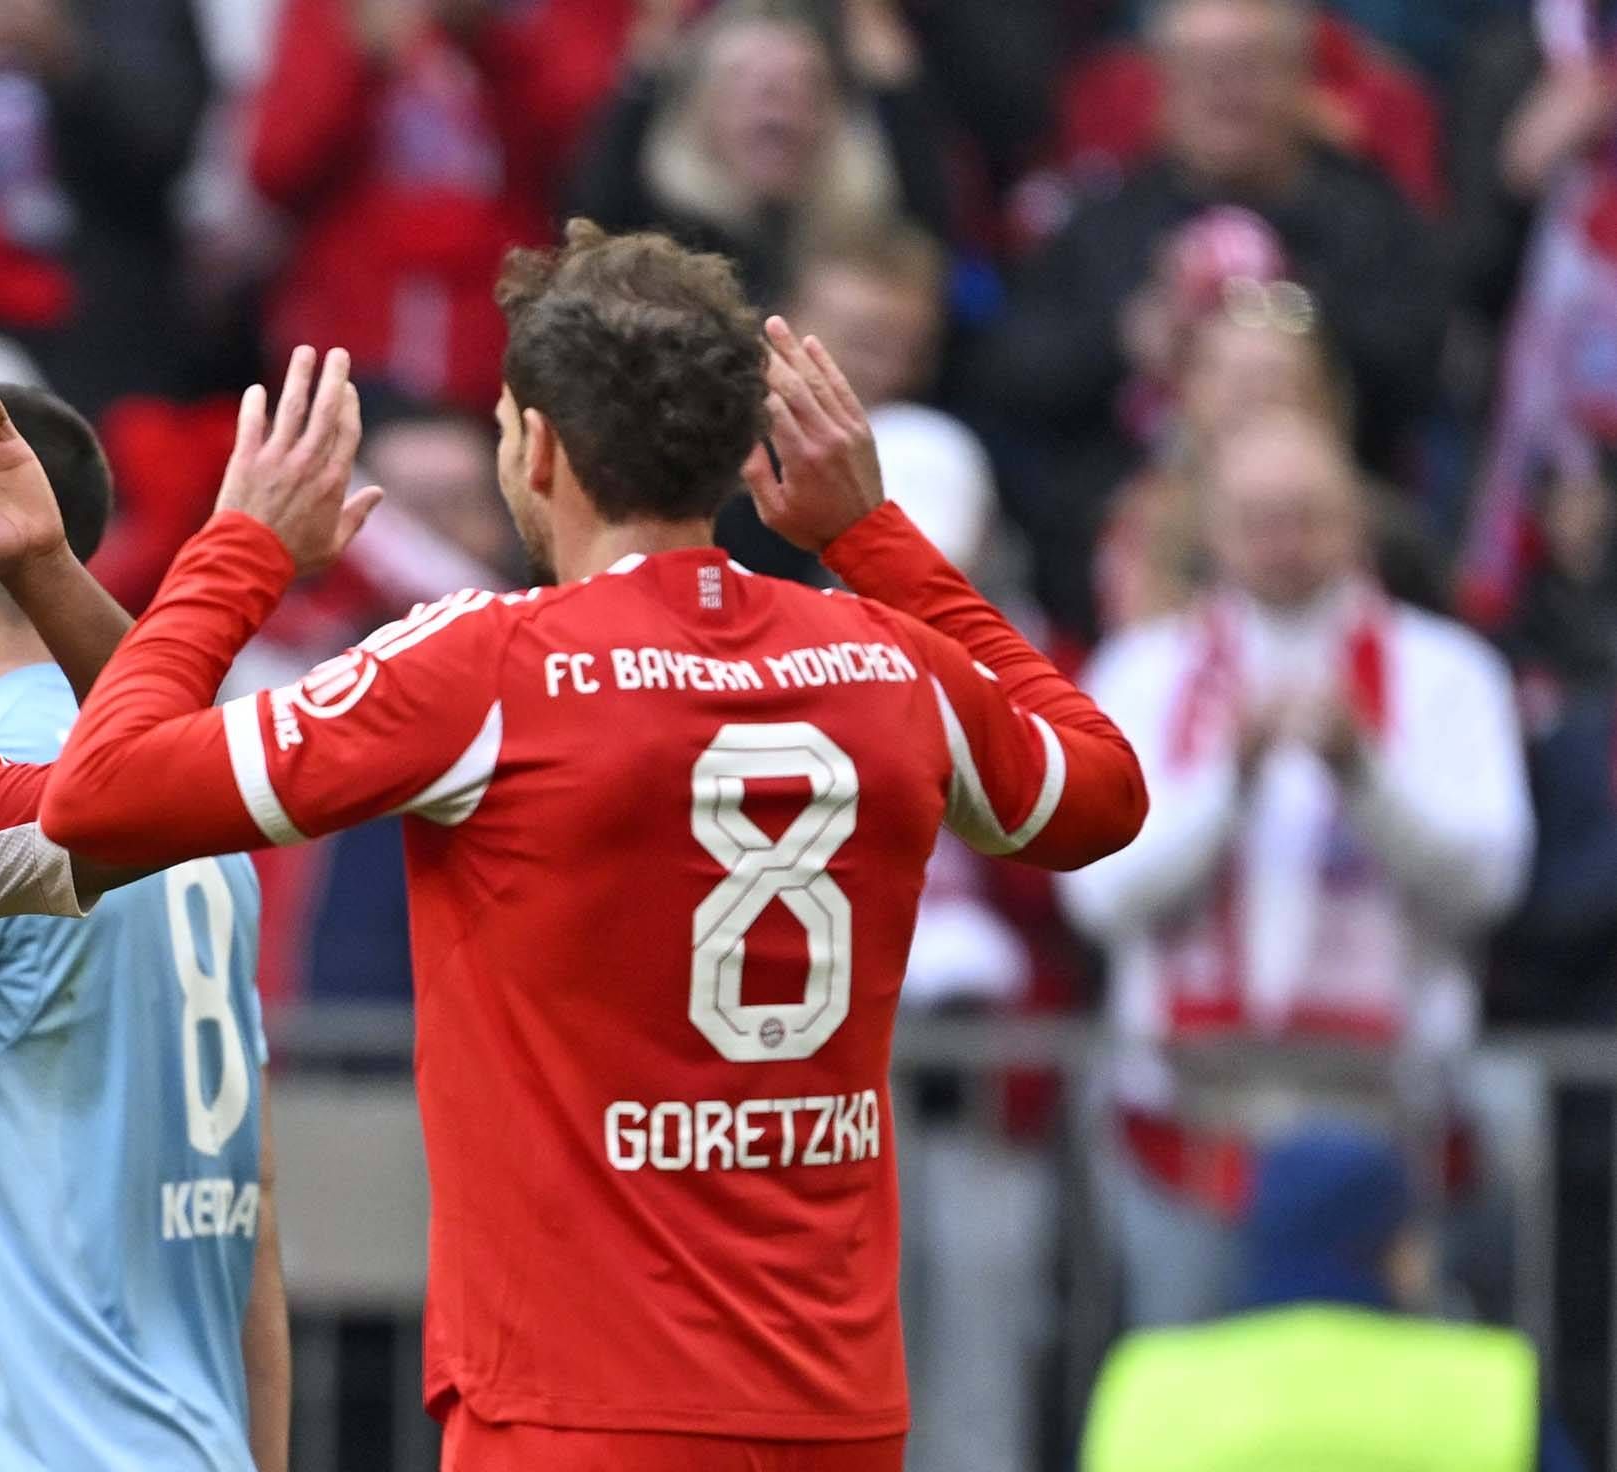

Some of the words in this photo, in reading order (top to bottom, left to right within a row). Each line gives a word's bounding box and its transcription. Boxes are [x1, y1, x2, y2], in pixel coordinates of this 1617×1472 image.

[544, 653, 600, 697] FC
[610, 647, 763, 691] BAYERN
[688, 721, 860, 1063] 8
[165, 855, 250, 1157] 8
[604, 1089, 880, 1171] GORETZKA
